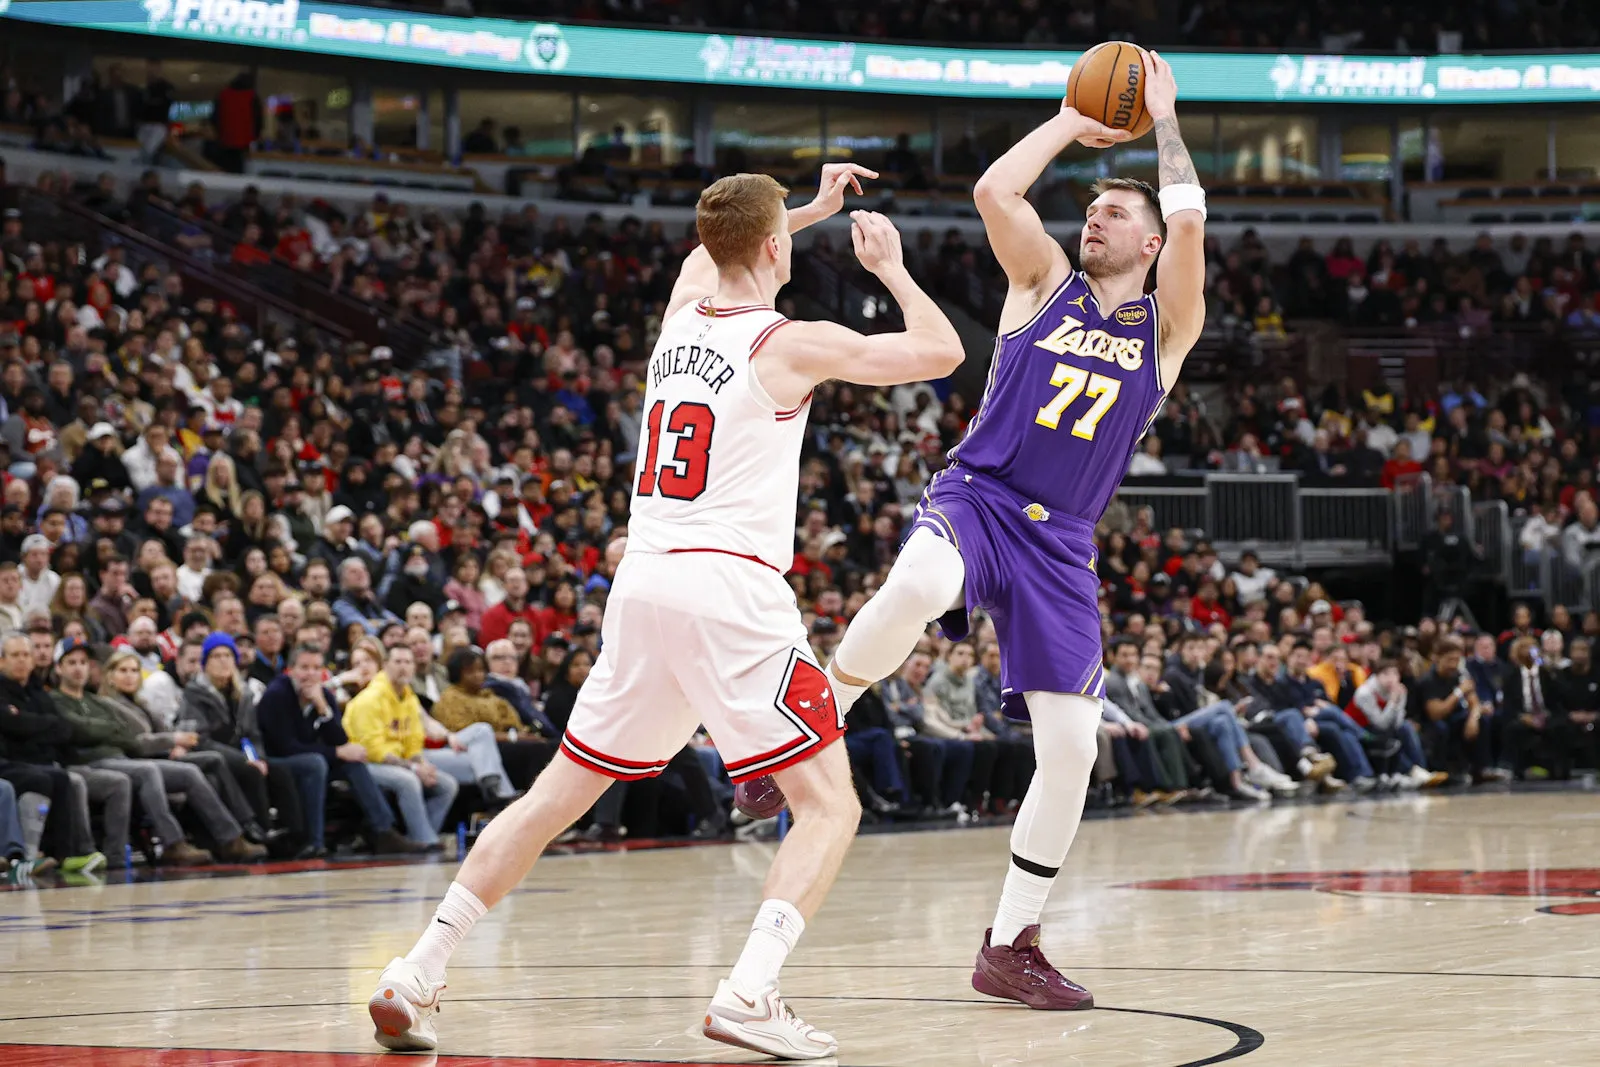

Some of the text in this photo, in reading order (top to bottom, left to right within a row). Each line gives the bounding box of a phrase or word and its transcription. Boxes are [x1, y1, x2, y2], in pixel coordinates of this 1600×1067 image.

[1112, 63, 1139, 127] Wilson
[1301, 55, 1426, 89] Flood
[1033, 314, 1145, 371] LAKERS
[1118, 310, 1145, 319] bibigo
[652, 345, 735, 394] HUERTER
[1034, 362, 1122, 441] 77
[636, 399, 716, 502] 13
